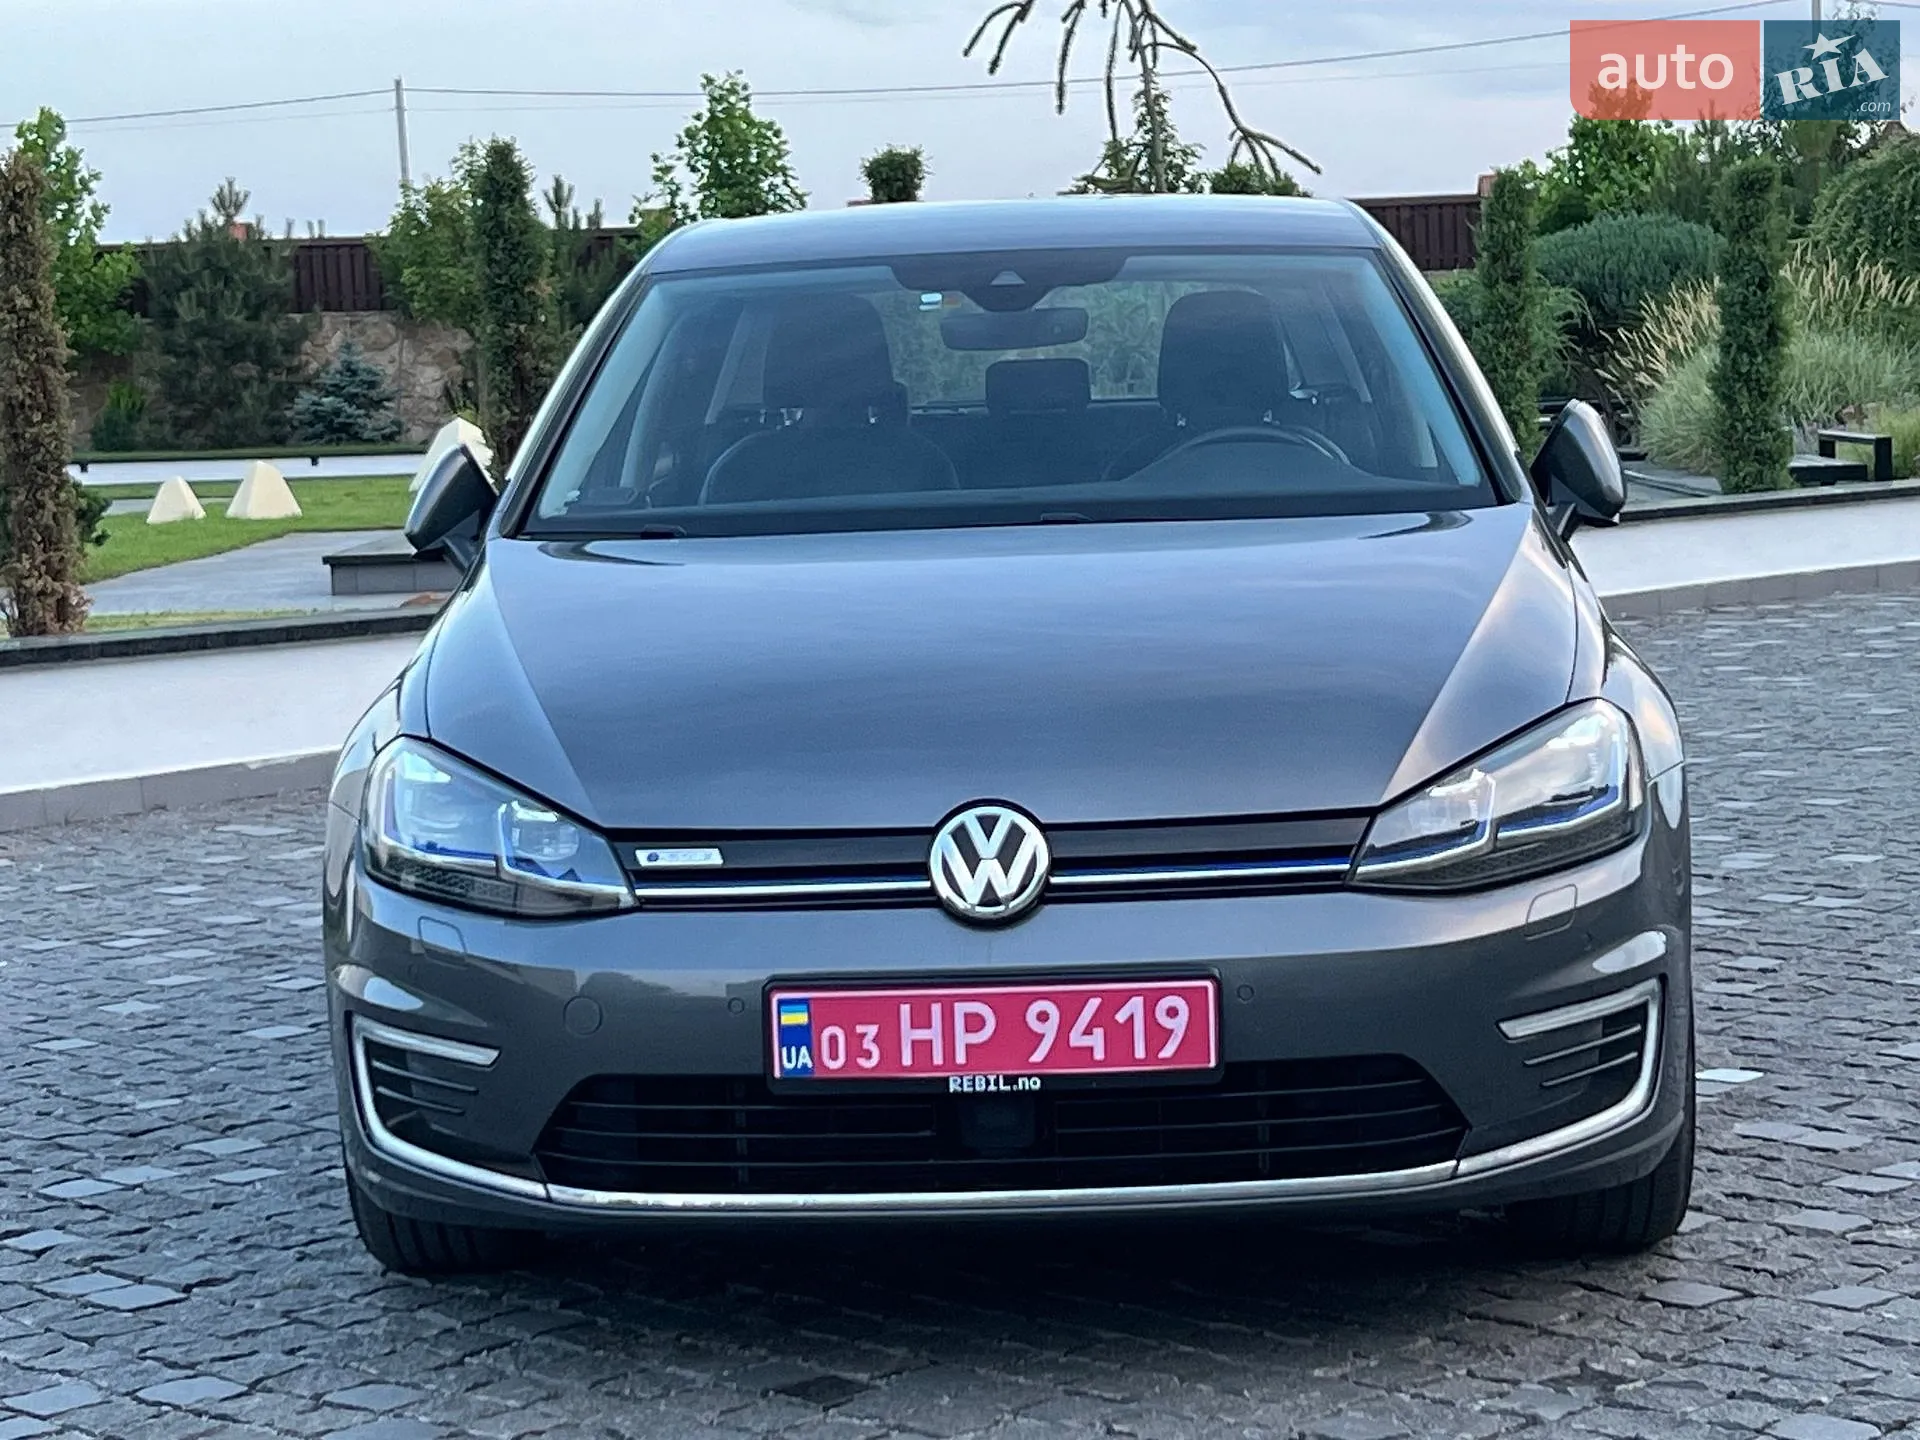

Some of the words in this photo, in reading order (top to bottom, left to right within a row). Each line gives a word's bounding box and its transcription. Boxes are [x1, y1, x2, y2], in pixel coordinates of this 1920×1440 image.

[820, 1023, 881, 1070] 03
[899, 1001, 997, 1067] HP
[1024, 994, 1190, 1064] 9419
[781, 1045, 813, 1070] UA
[948, 1075, 1042, 1093] REBIL.no
